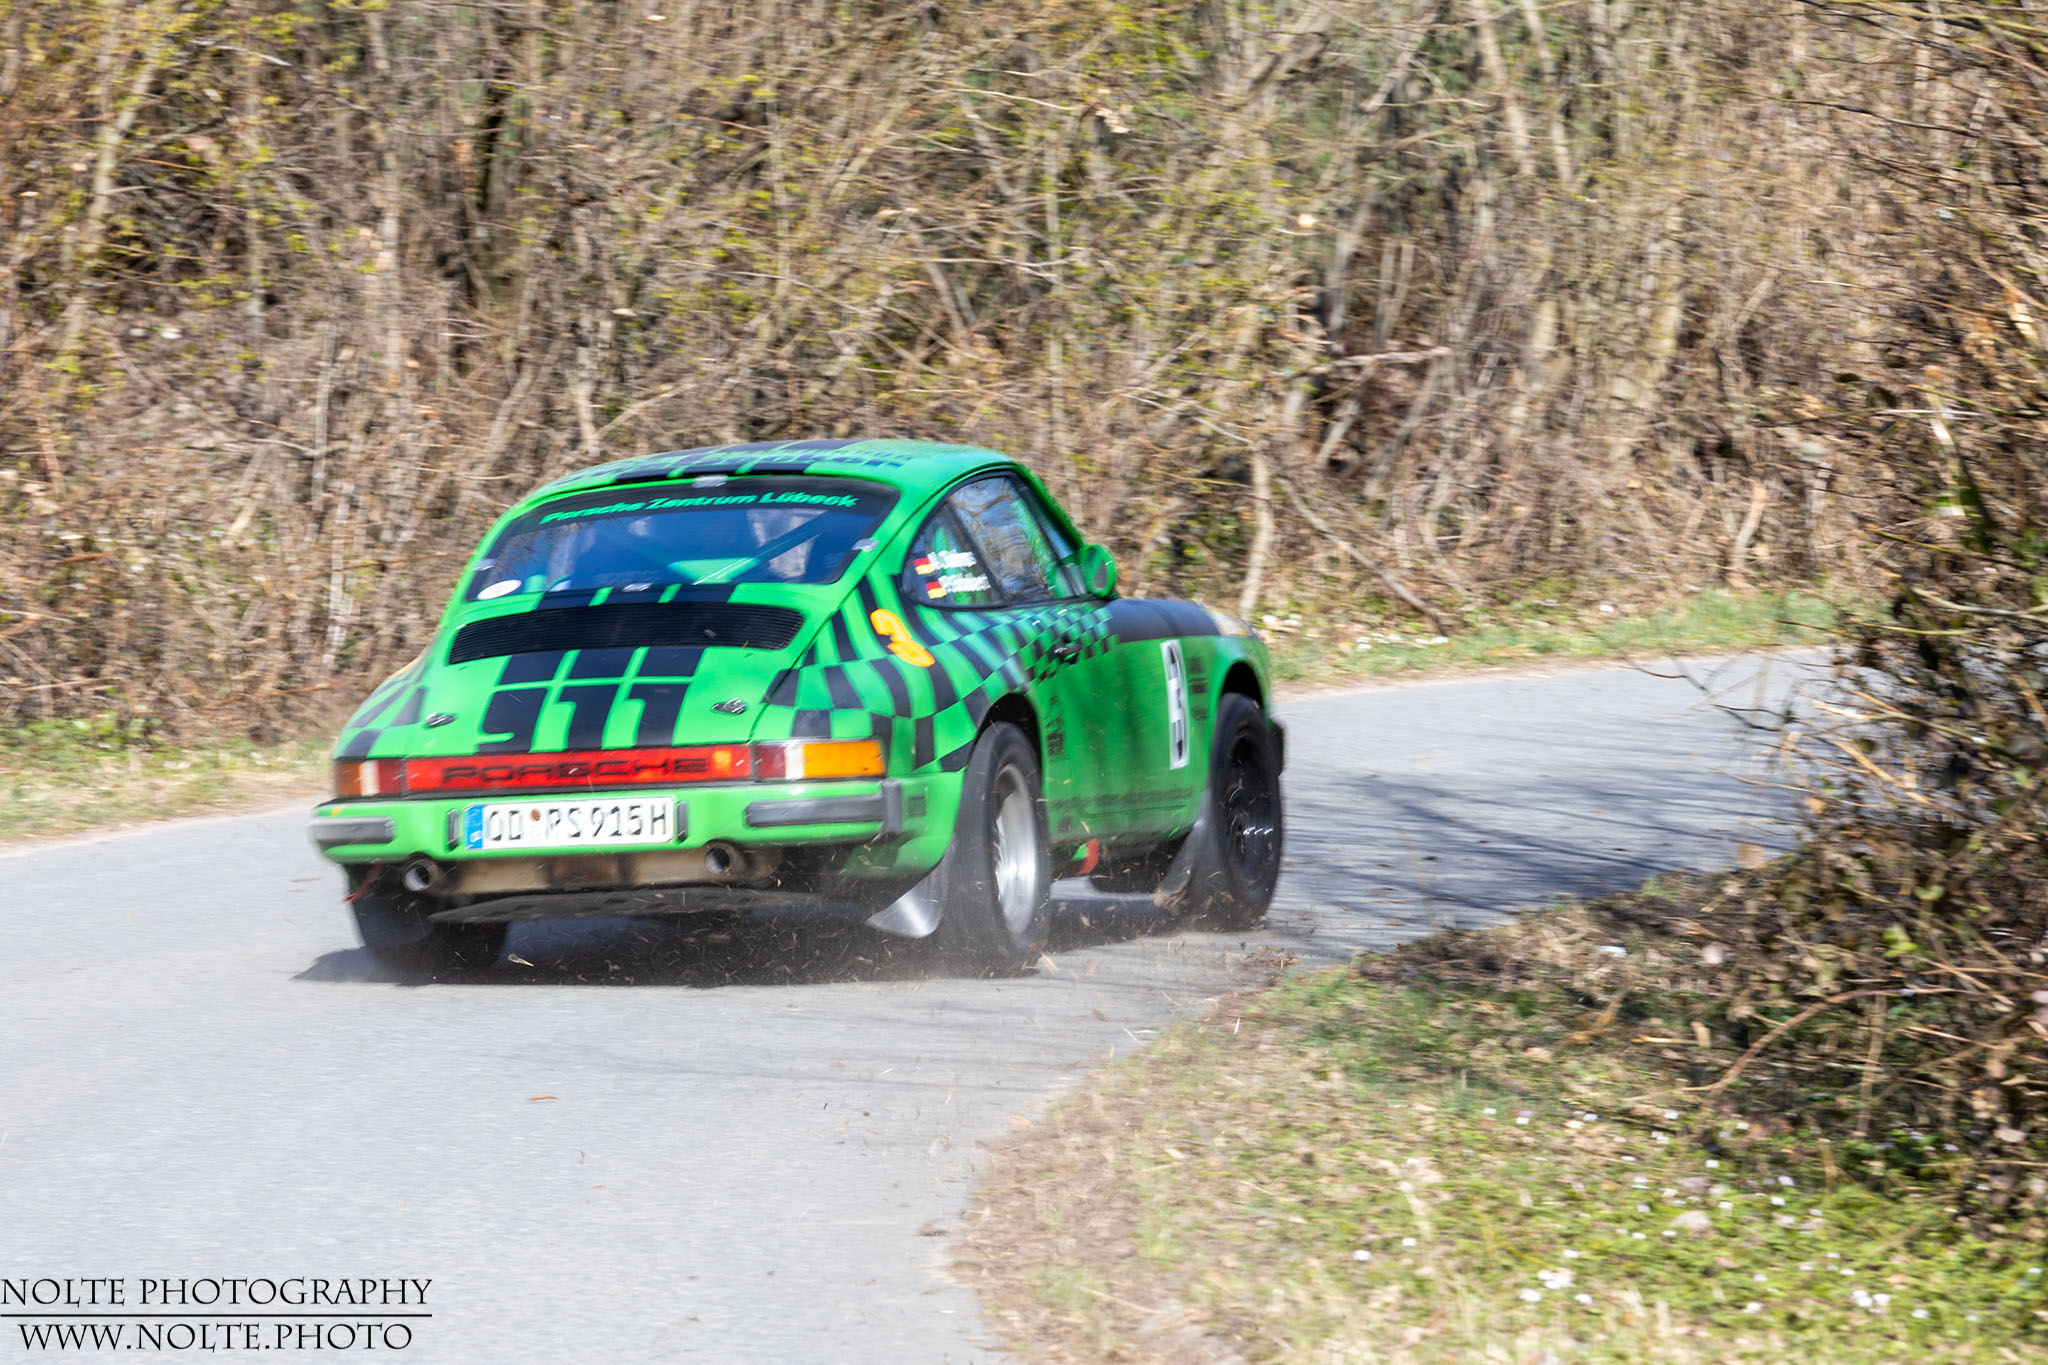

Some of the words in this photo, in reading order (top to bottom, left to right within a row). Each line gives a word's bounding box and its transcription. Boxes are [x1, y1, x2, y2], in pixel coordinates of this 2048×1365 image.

[539, 502, 646, 525] Porsche
[645, 494, 758, 510] Zentrum
[758, 491, 858, 508] Lübeck
[442, 758, 709, 784] PORSCHE
